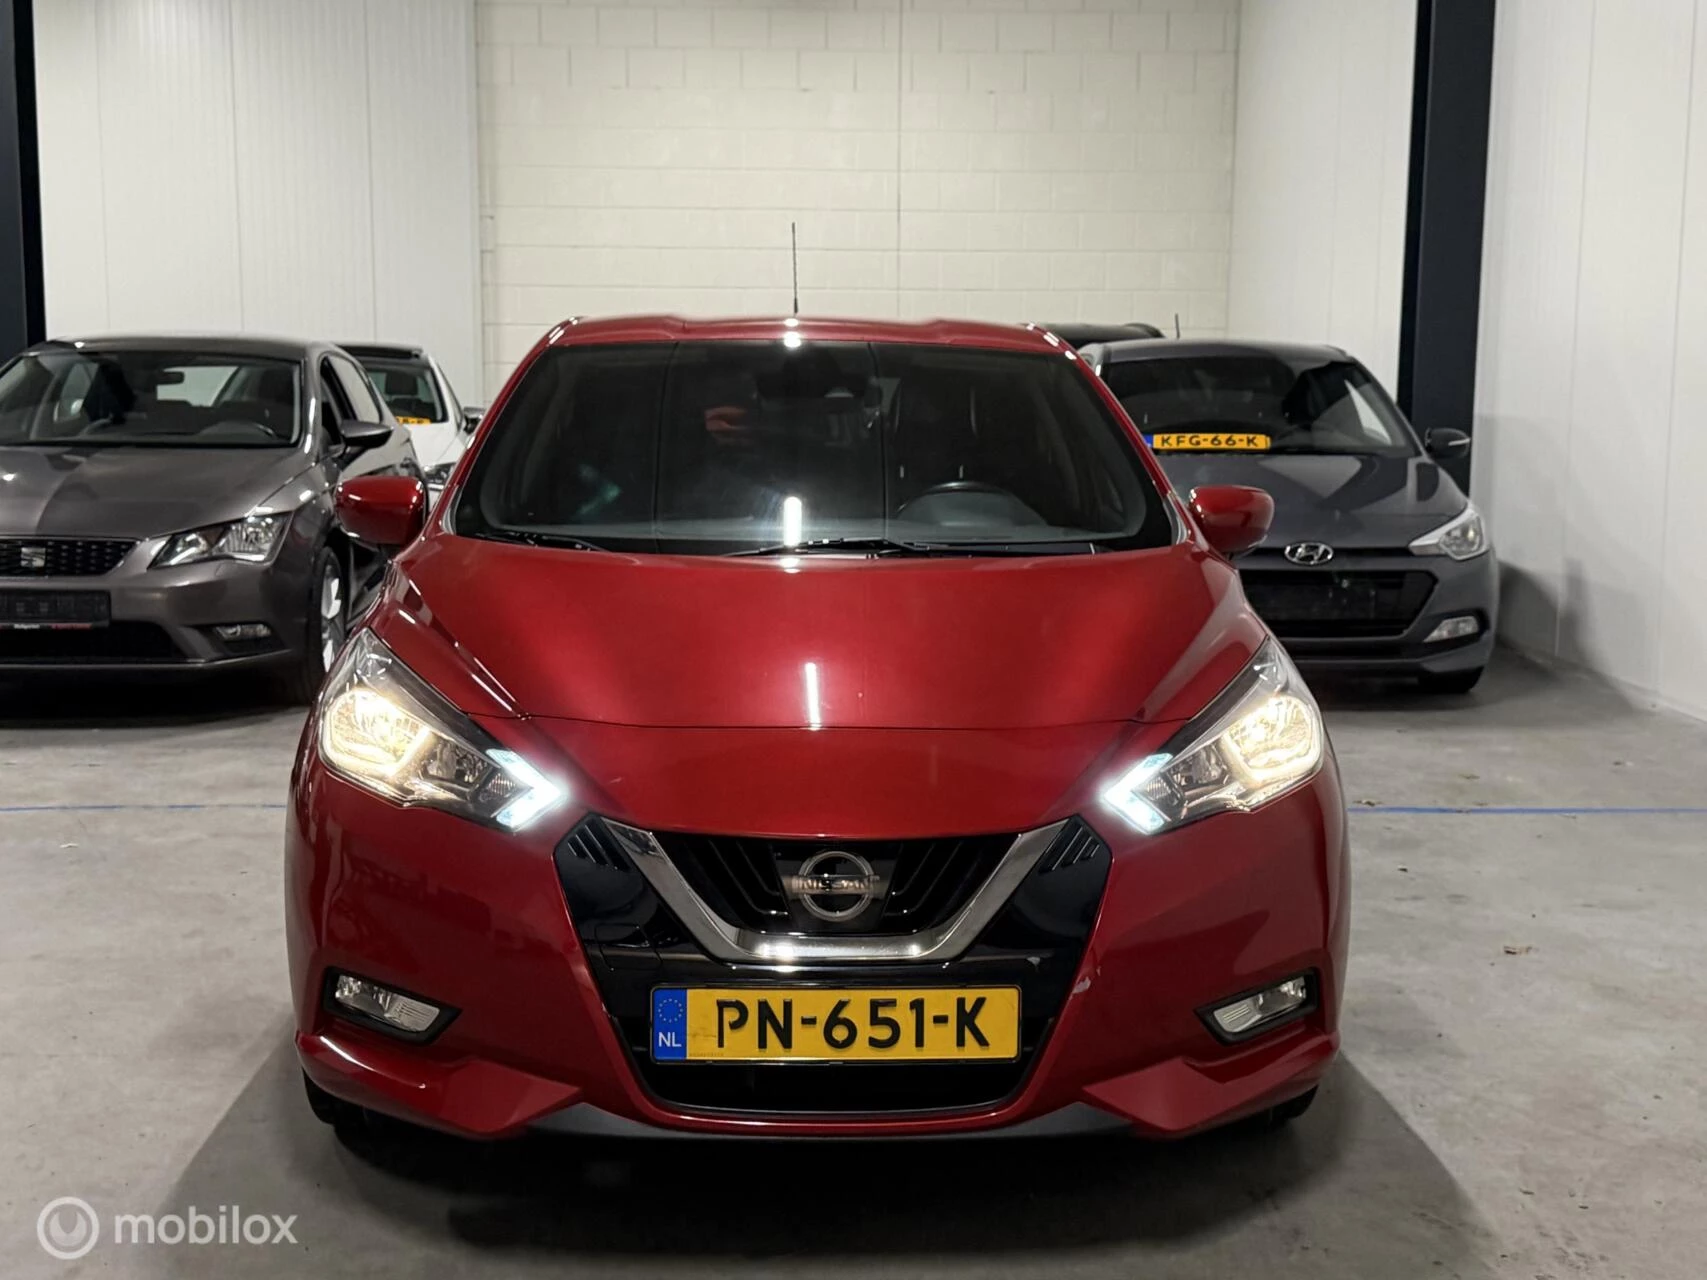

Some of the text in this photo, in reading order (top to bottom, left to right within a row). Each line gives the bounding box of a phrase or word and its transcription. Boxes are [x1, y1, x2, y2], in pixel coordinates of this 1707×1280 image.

[1160, 434, 1259, 447] KFG-66-K
[802, 879, 871, 890] NISSAN
[658, 997, 990, 1050] NL PN-651-K
